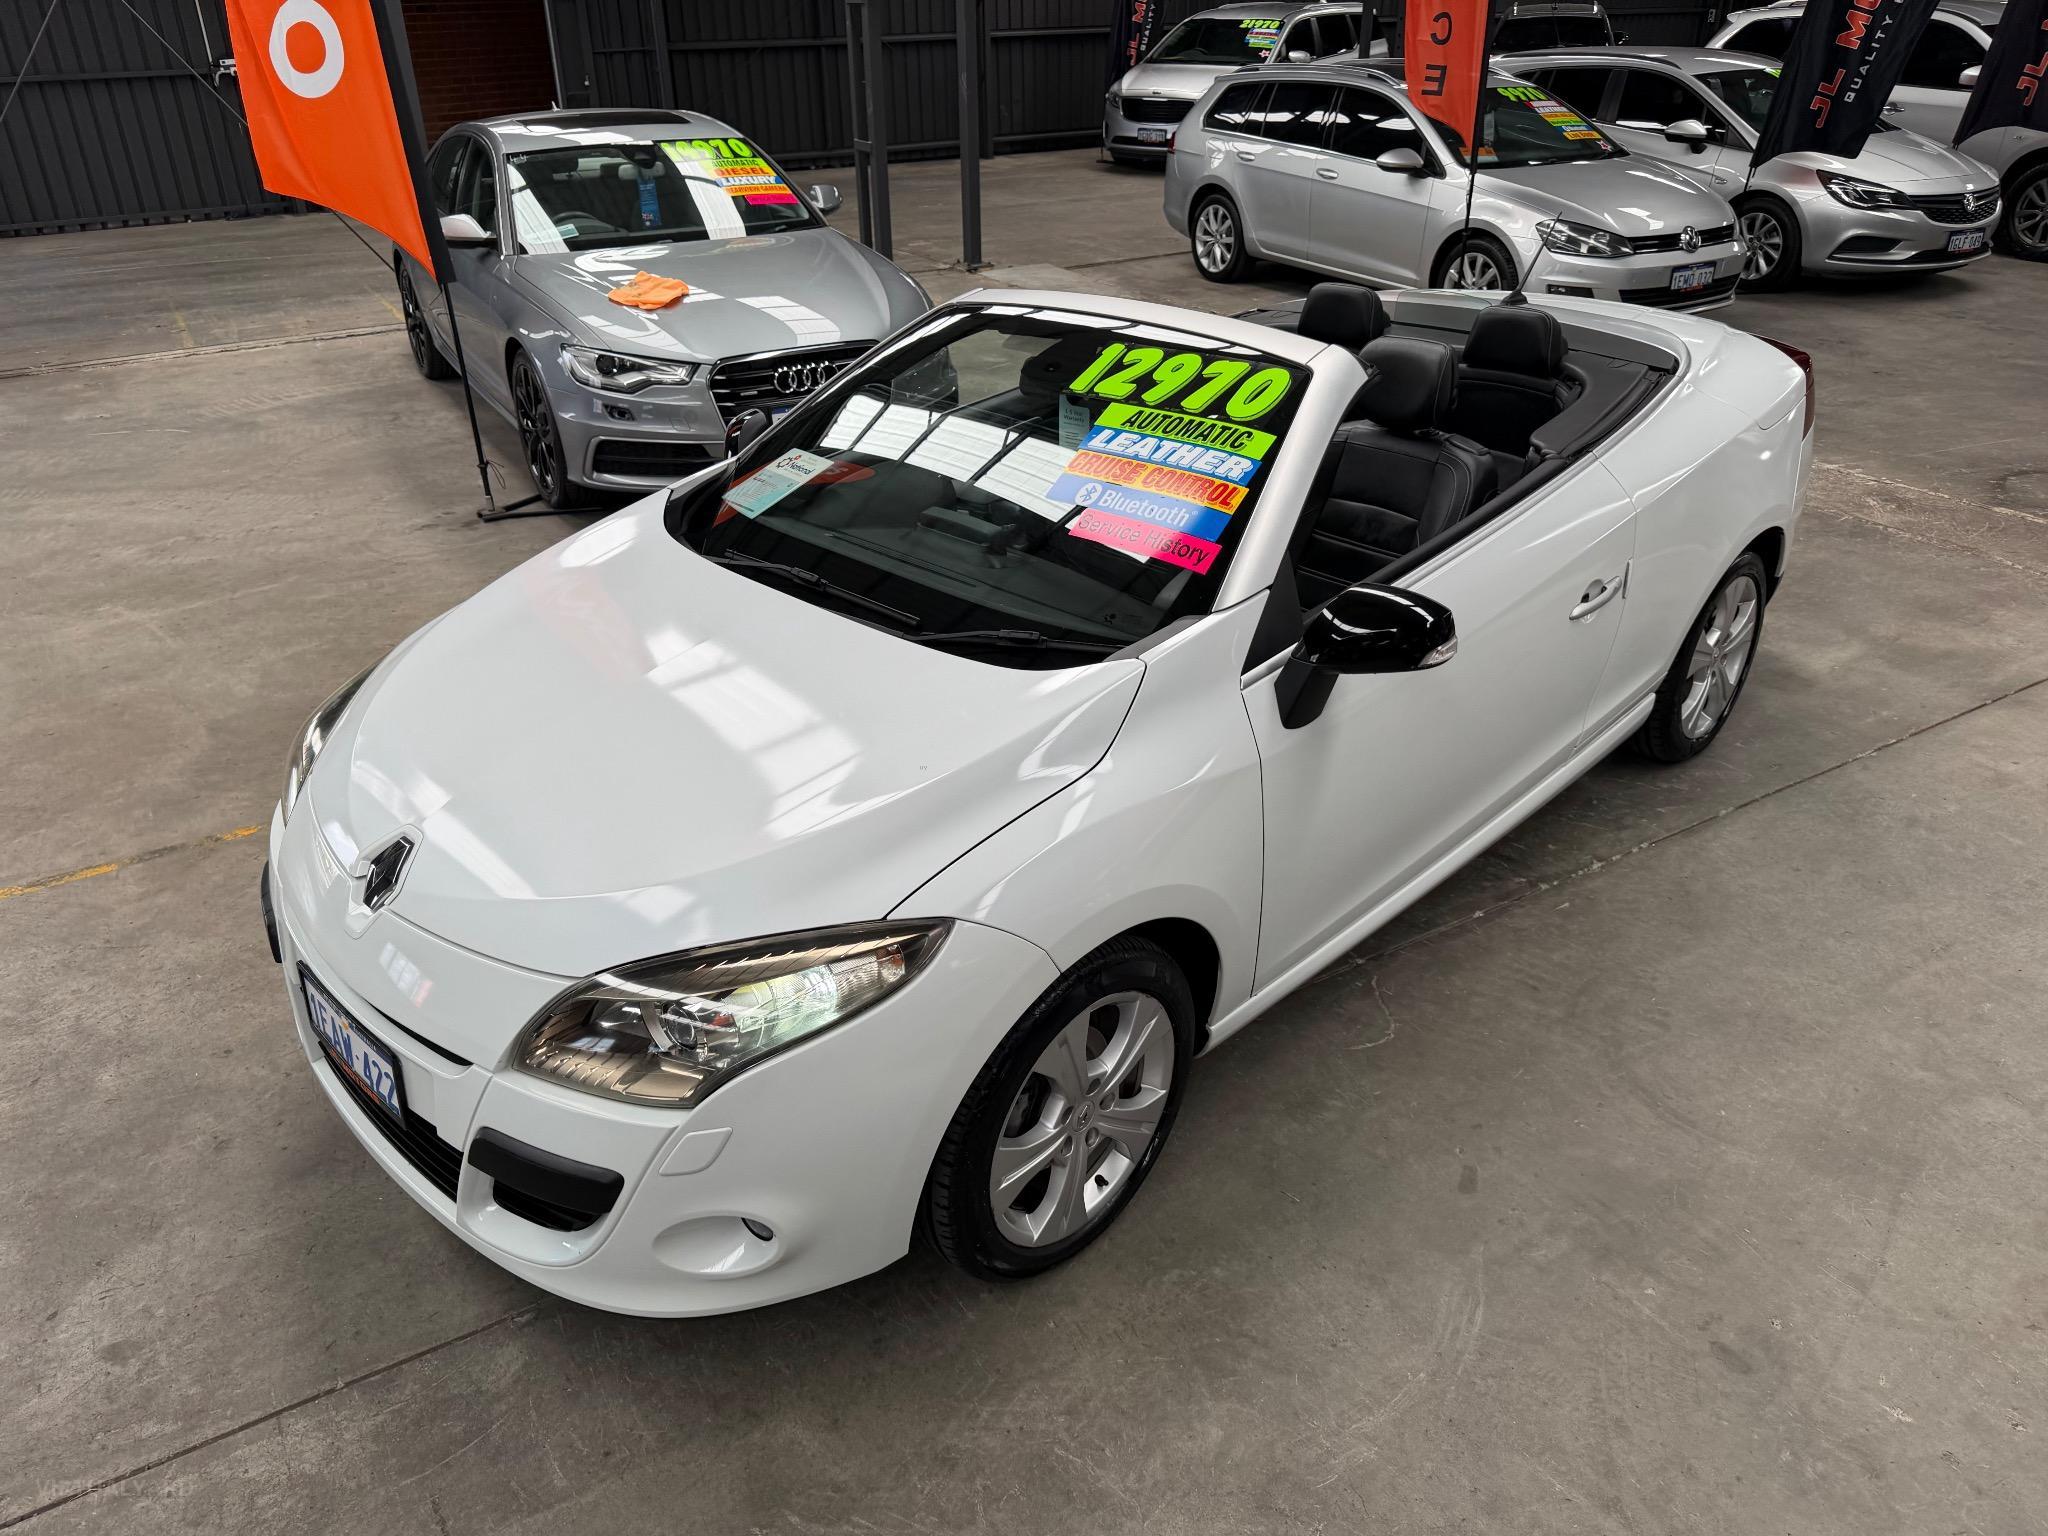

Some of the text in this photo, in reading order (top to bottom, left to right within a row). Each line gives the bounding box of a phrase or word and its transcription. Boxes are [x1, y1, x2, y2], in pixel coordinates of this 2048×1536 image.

[1132, 0, 1147, 23] M
[1140, 4, 1155, 50] QUALITY
[1239, 19, 1280, 29] 21970
[1844, 15, 1893, 102] QUALITY
[2016, 51, 2048, 106] JL
[1497, 87, 1548, 102] 9970
[1810, 68, 1846, 128] JL
[713, 159, 758, 168] AUTOMATIC
[714, 167, 769, 176] DIESEL
[721, 176, 777, 185] LUXURY
[1069, 343, 1292, 422] 12970
[1121, 410, 1254, 450] AUTOMATIC
[1087, 428, 1254, 482] LEATHER
[1067, 451, 1241, 510] CRUISE CONTROL
[1099, 489, 1191, 528] Bluetooth
[1078, 514, 1210, 567] Service History
[363, 1051, 400, 1116] 422
